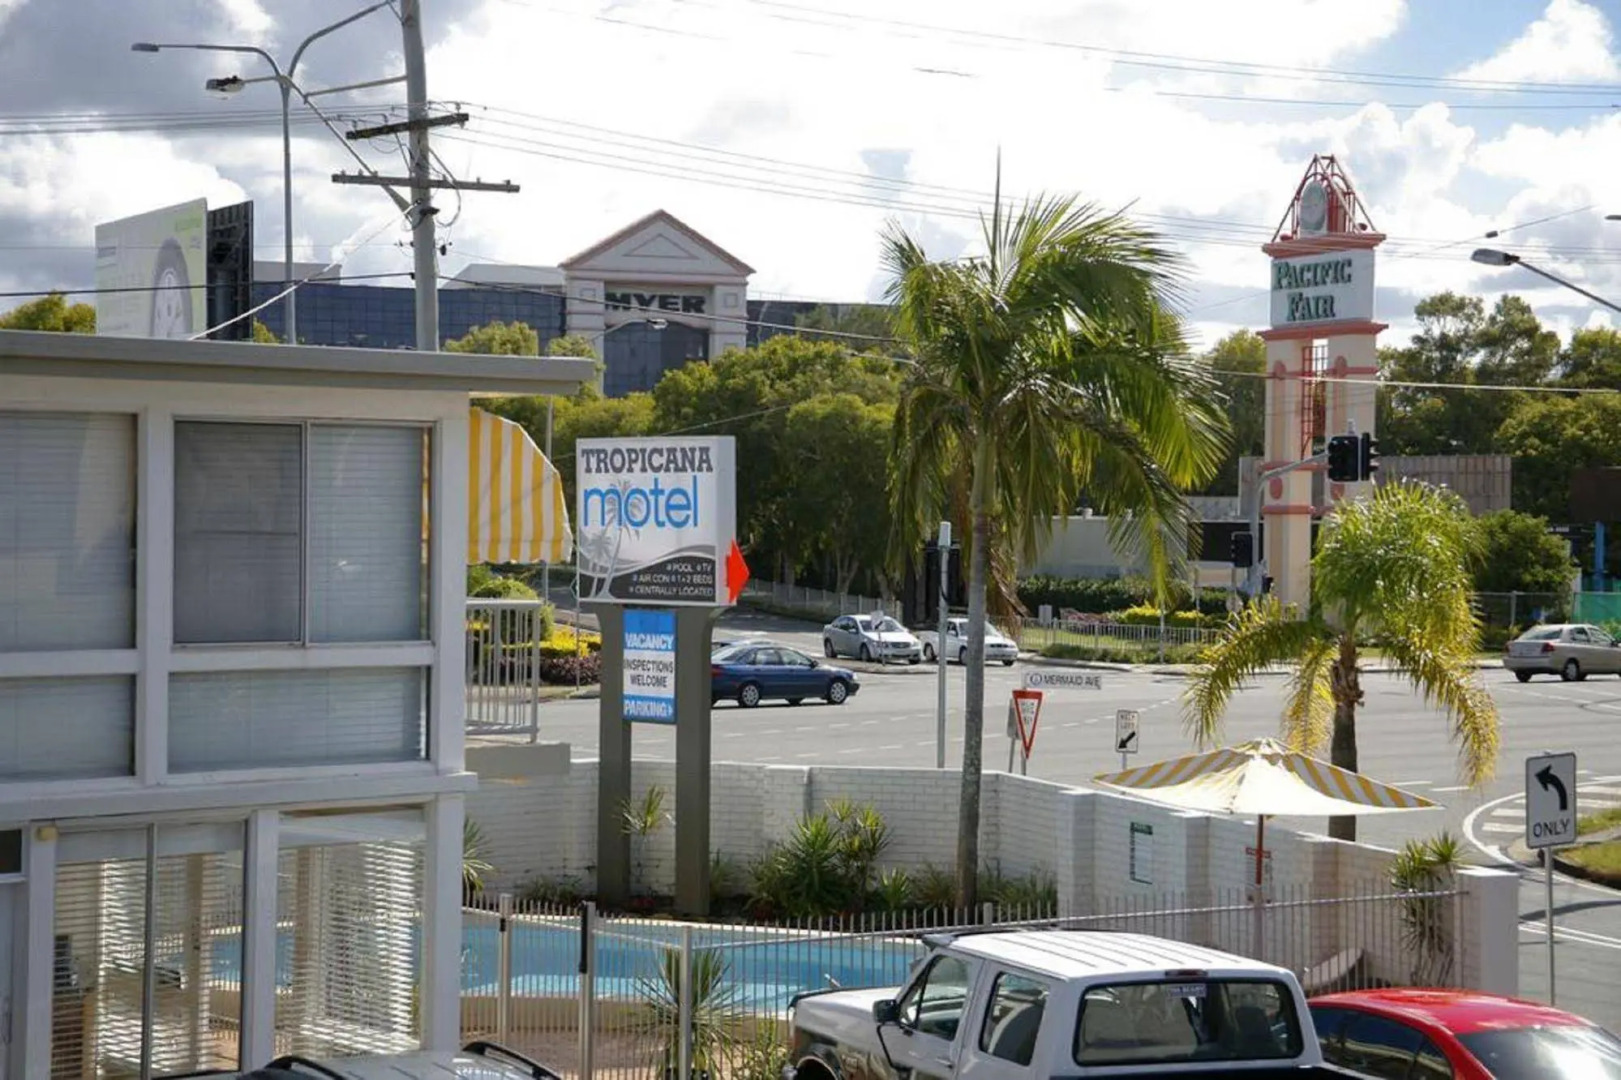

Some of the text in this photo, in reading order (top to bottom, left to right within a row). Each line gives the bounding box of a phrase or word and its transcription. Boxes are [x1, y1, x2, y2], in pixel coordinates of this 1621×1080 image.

[1273, 259, 1353, 289] PACIFIC
[604, 292, 706, 313] MYER
[1287, 292, 1336, 321] FAIR
[581, 447, 714, 473] TROPICANA
[583, 475, 699, 528] motel
[672, 562, 693, 572] POOL
[634, 585, 714, 597] CENTRALLY LOCATED
[624, 632, 675, 650] VACANCY
[630, 674, 668, 688] WELCOME
[1043, 674, 1083, 686] MERMAID
[624, 699, 666, 717] PARKING
[1533, 819, 1570, 838] ONLY
